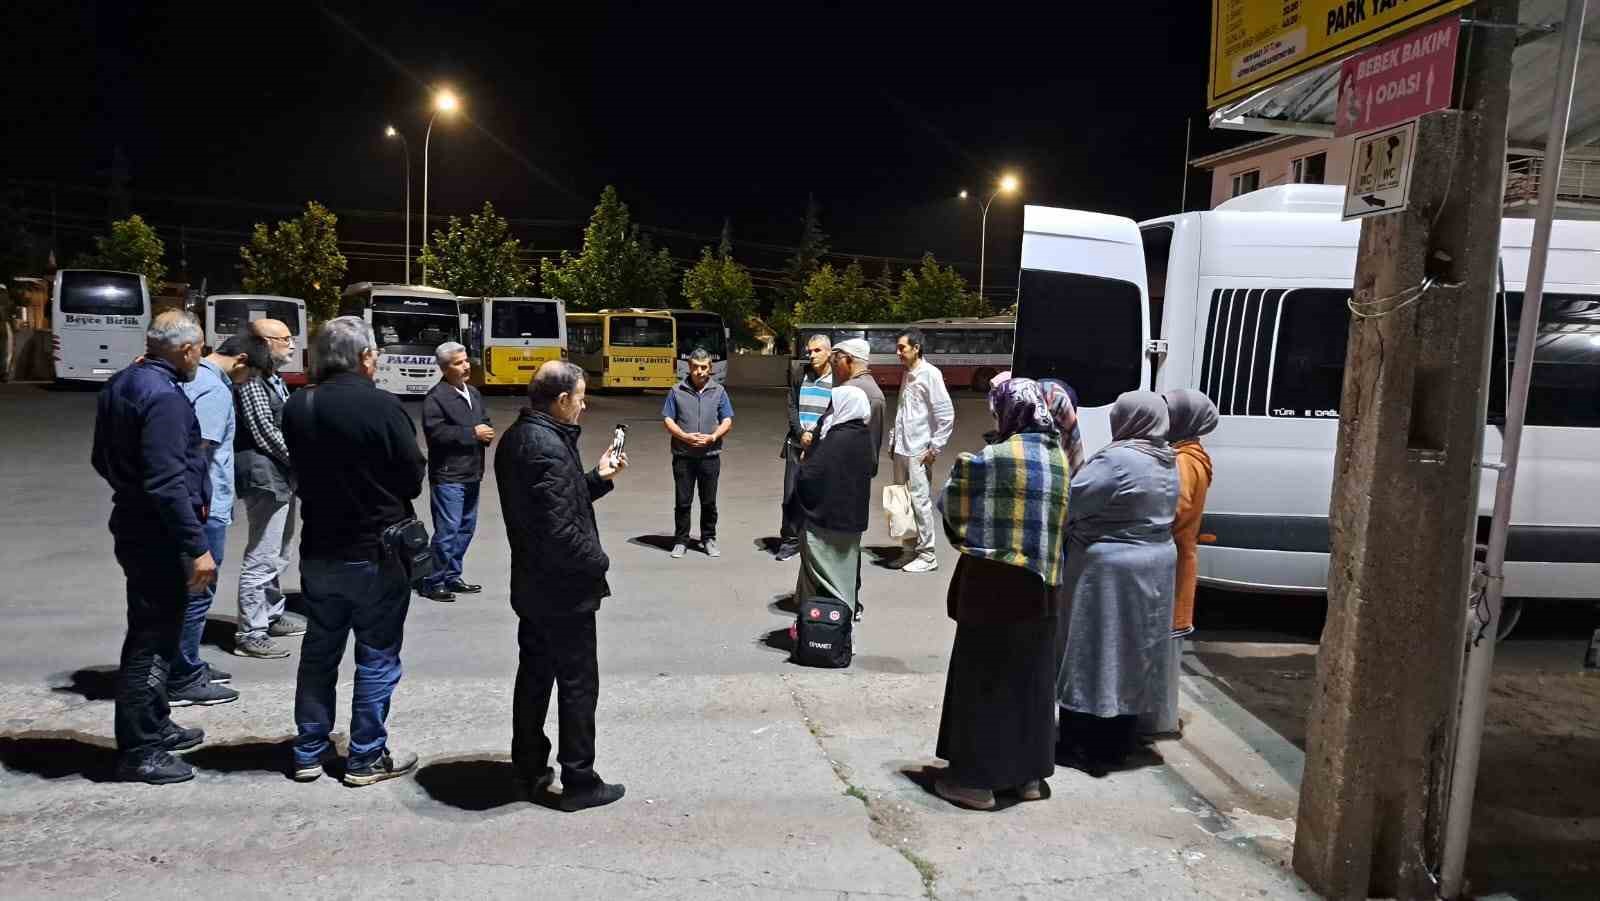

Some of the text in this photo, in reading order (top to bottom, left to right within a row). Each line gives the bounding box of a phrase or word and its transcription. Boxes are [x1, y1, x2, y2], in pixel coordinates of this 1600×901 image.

[1327, 0, 1366, 35] PARK
[1357, 26, 1452, 80] BEBEK BAKIM
[1375, 71, 1421, 104] ODASI
[1384, 167, 1396, 179] WC
[106, 316, 139, 325] Birlik
[387, 355, 433, 365] PAZARL
